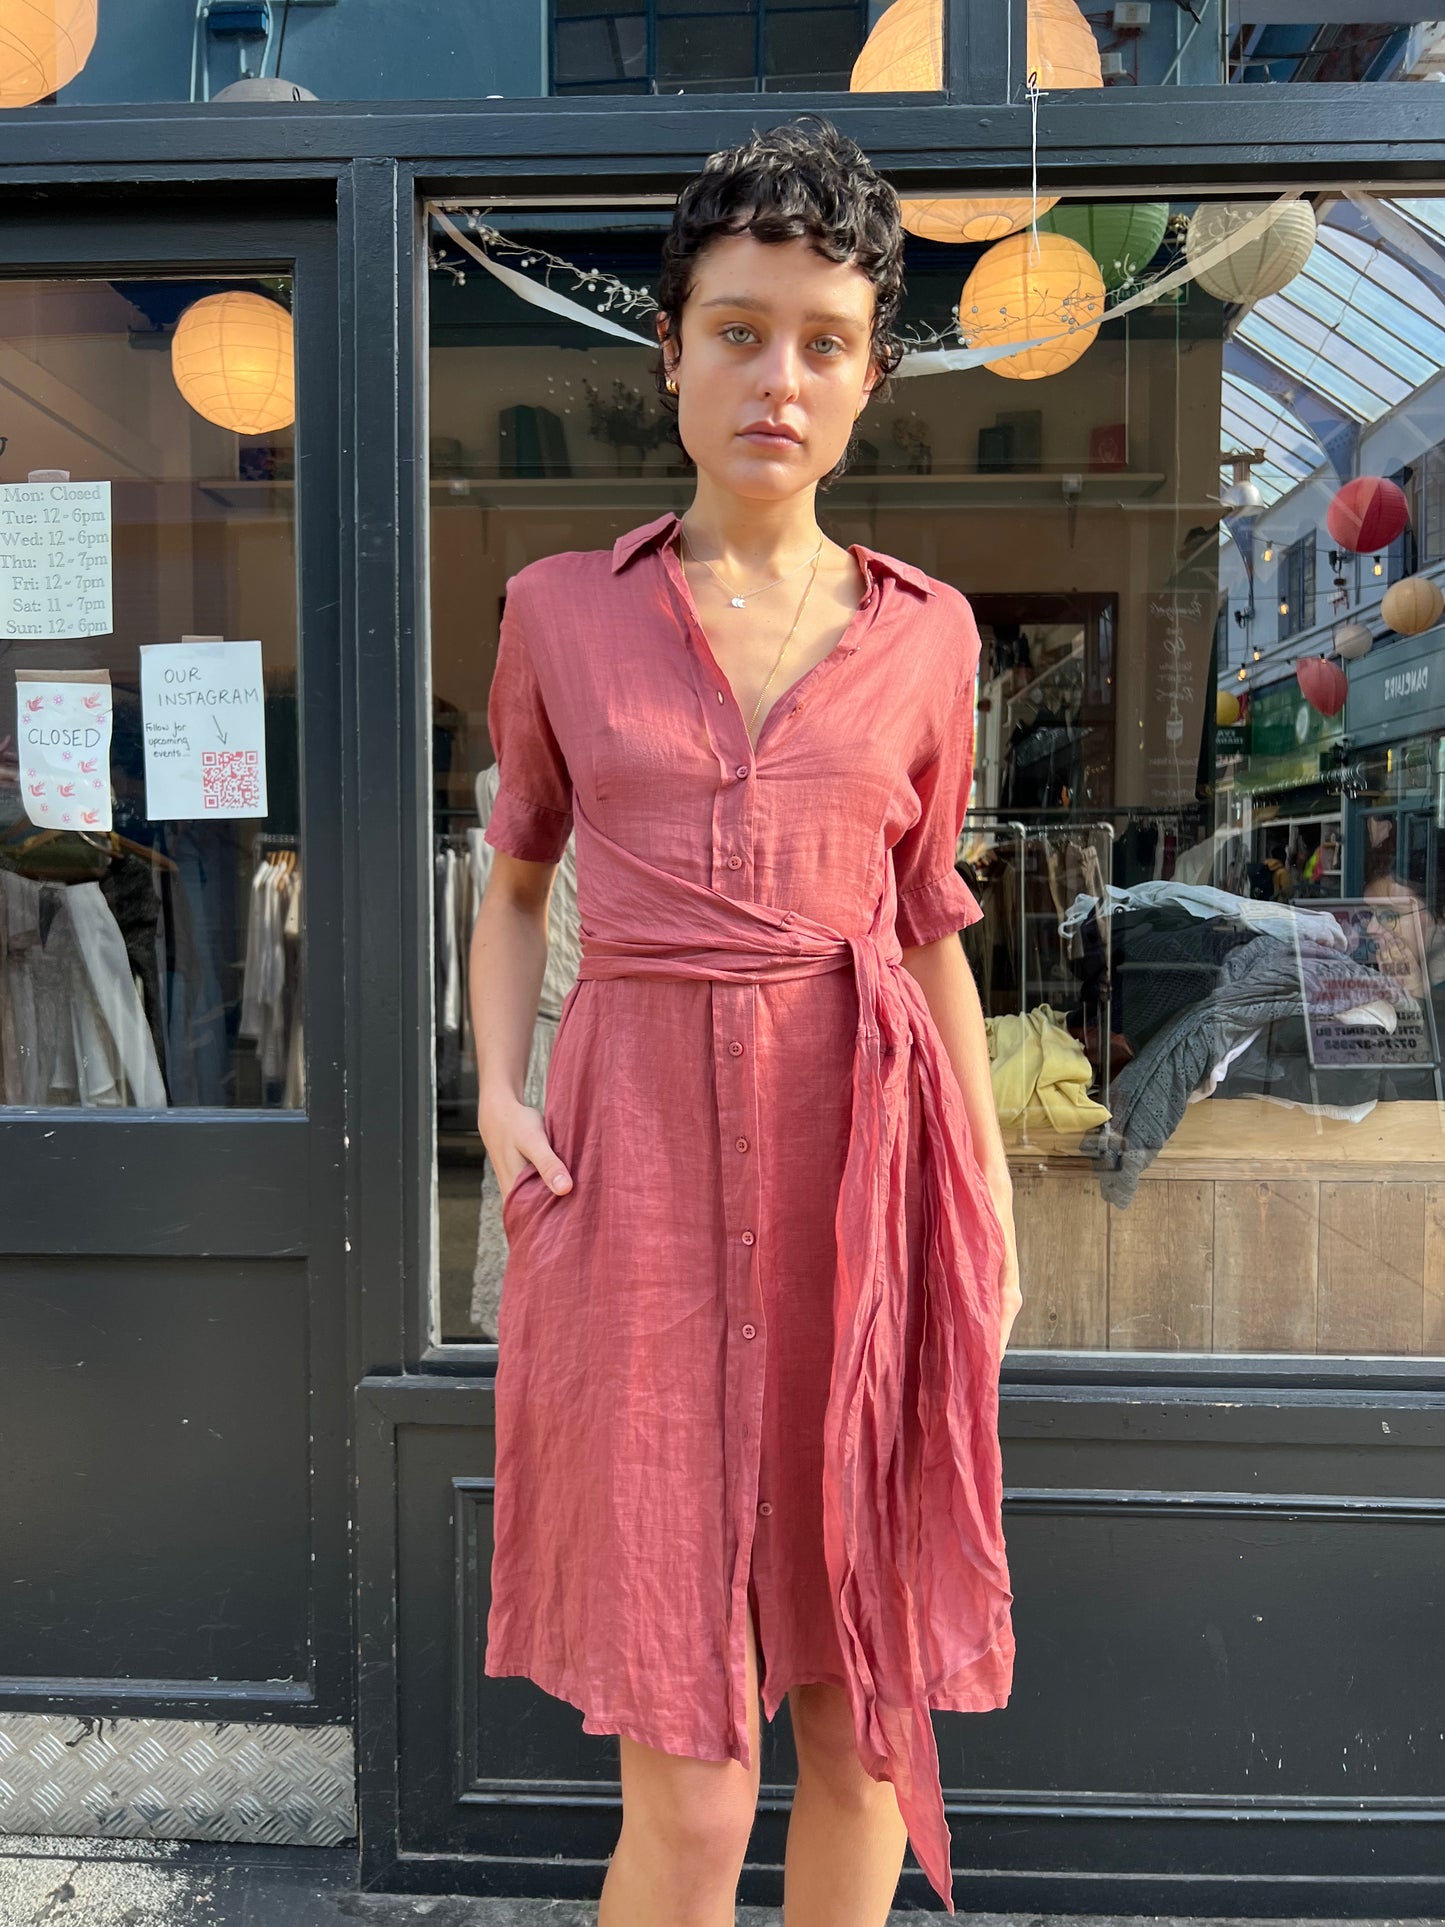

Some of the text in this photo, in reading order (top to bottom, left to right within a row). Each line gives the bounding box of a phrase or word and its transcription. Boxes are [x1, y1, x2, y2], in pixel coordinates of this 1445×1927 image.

[4, 485, 101, 502] Mon: Closed
[2, 510, 37, 524] Tue:
[0, 531, 43, 546] Wed:
[0, 554, 37, 569] Thu:
[12, 576, 39, 590] Fri:
[13, 598, 41, 612] Sat:
[6, 620, 42, 634] Sun:
[164, 667, 201, 684] OUR
[158, 688, 259, 706] INSTAGRAM
[145, 722, 187, 738] Follow for
[27, 728, 101, 748] CLOSED
[148, 737, 190, 751] upcoming
